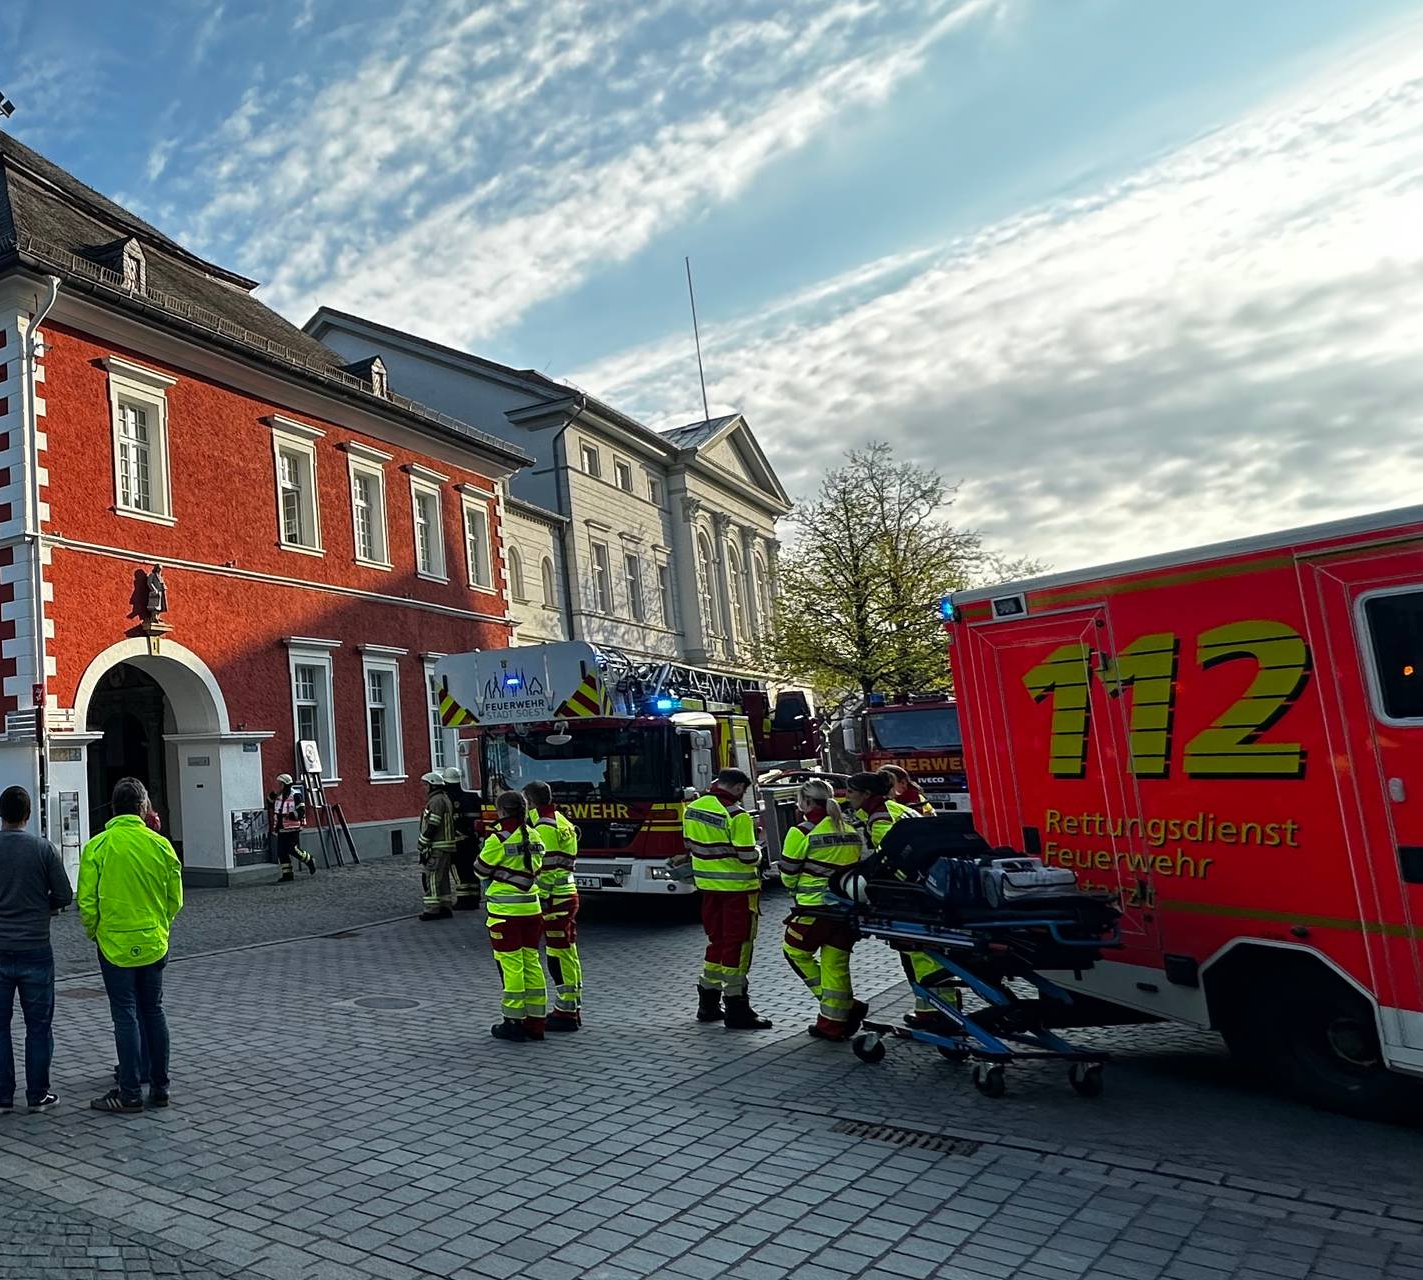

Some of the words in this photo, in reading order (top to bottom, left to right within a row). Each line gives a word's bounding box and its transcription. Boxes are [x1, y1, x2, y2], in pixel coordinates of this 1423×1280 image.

[485, 700, 546, 711] FEUERWEHR
[1022, 619, 1312, 779] 112
[486, 711, 514, 720] STADT
[516, 708, 546, 717] SOEST
[870, 757, 962, 771] FEUERWE
[554, 803, 630, 819] RWEHR
[1044, 808, 1299, 847] Rettungsdienst
[1043, 841, 1214, 878] Feuerwehr
